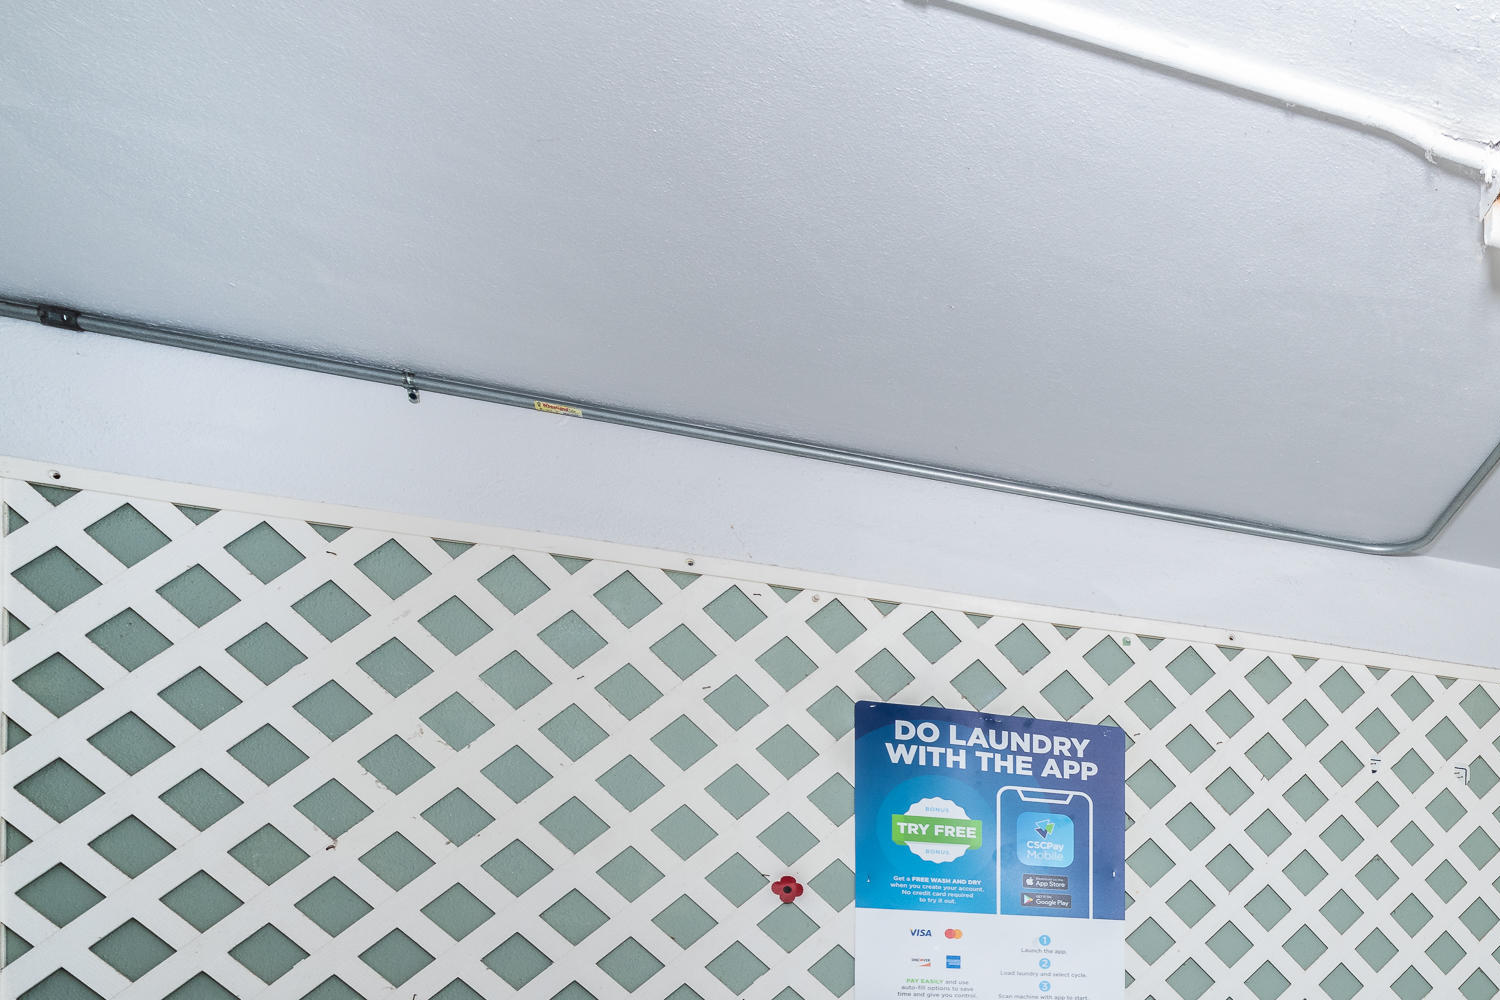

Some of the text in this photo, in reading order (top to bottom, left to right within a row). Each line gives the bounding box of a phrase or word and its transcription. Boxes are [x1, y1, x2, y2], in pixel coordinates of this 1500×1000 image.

[894, 720, 1090, 758] DO LAUNDRY
[885, 742, 1098, 781] WITH THE APP
[925, 806, 949, 814] BONUS
[897, 822, 977, 838] TRY FREE
[1026, 840, 1064, 851] CSCPay
[925, 848, 949, 856] BONUS
[1026, 850, 1064, 860] Mobile
[1057, 899, 1069, 907] Play
[910, 929, 932, 937] VISA
